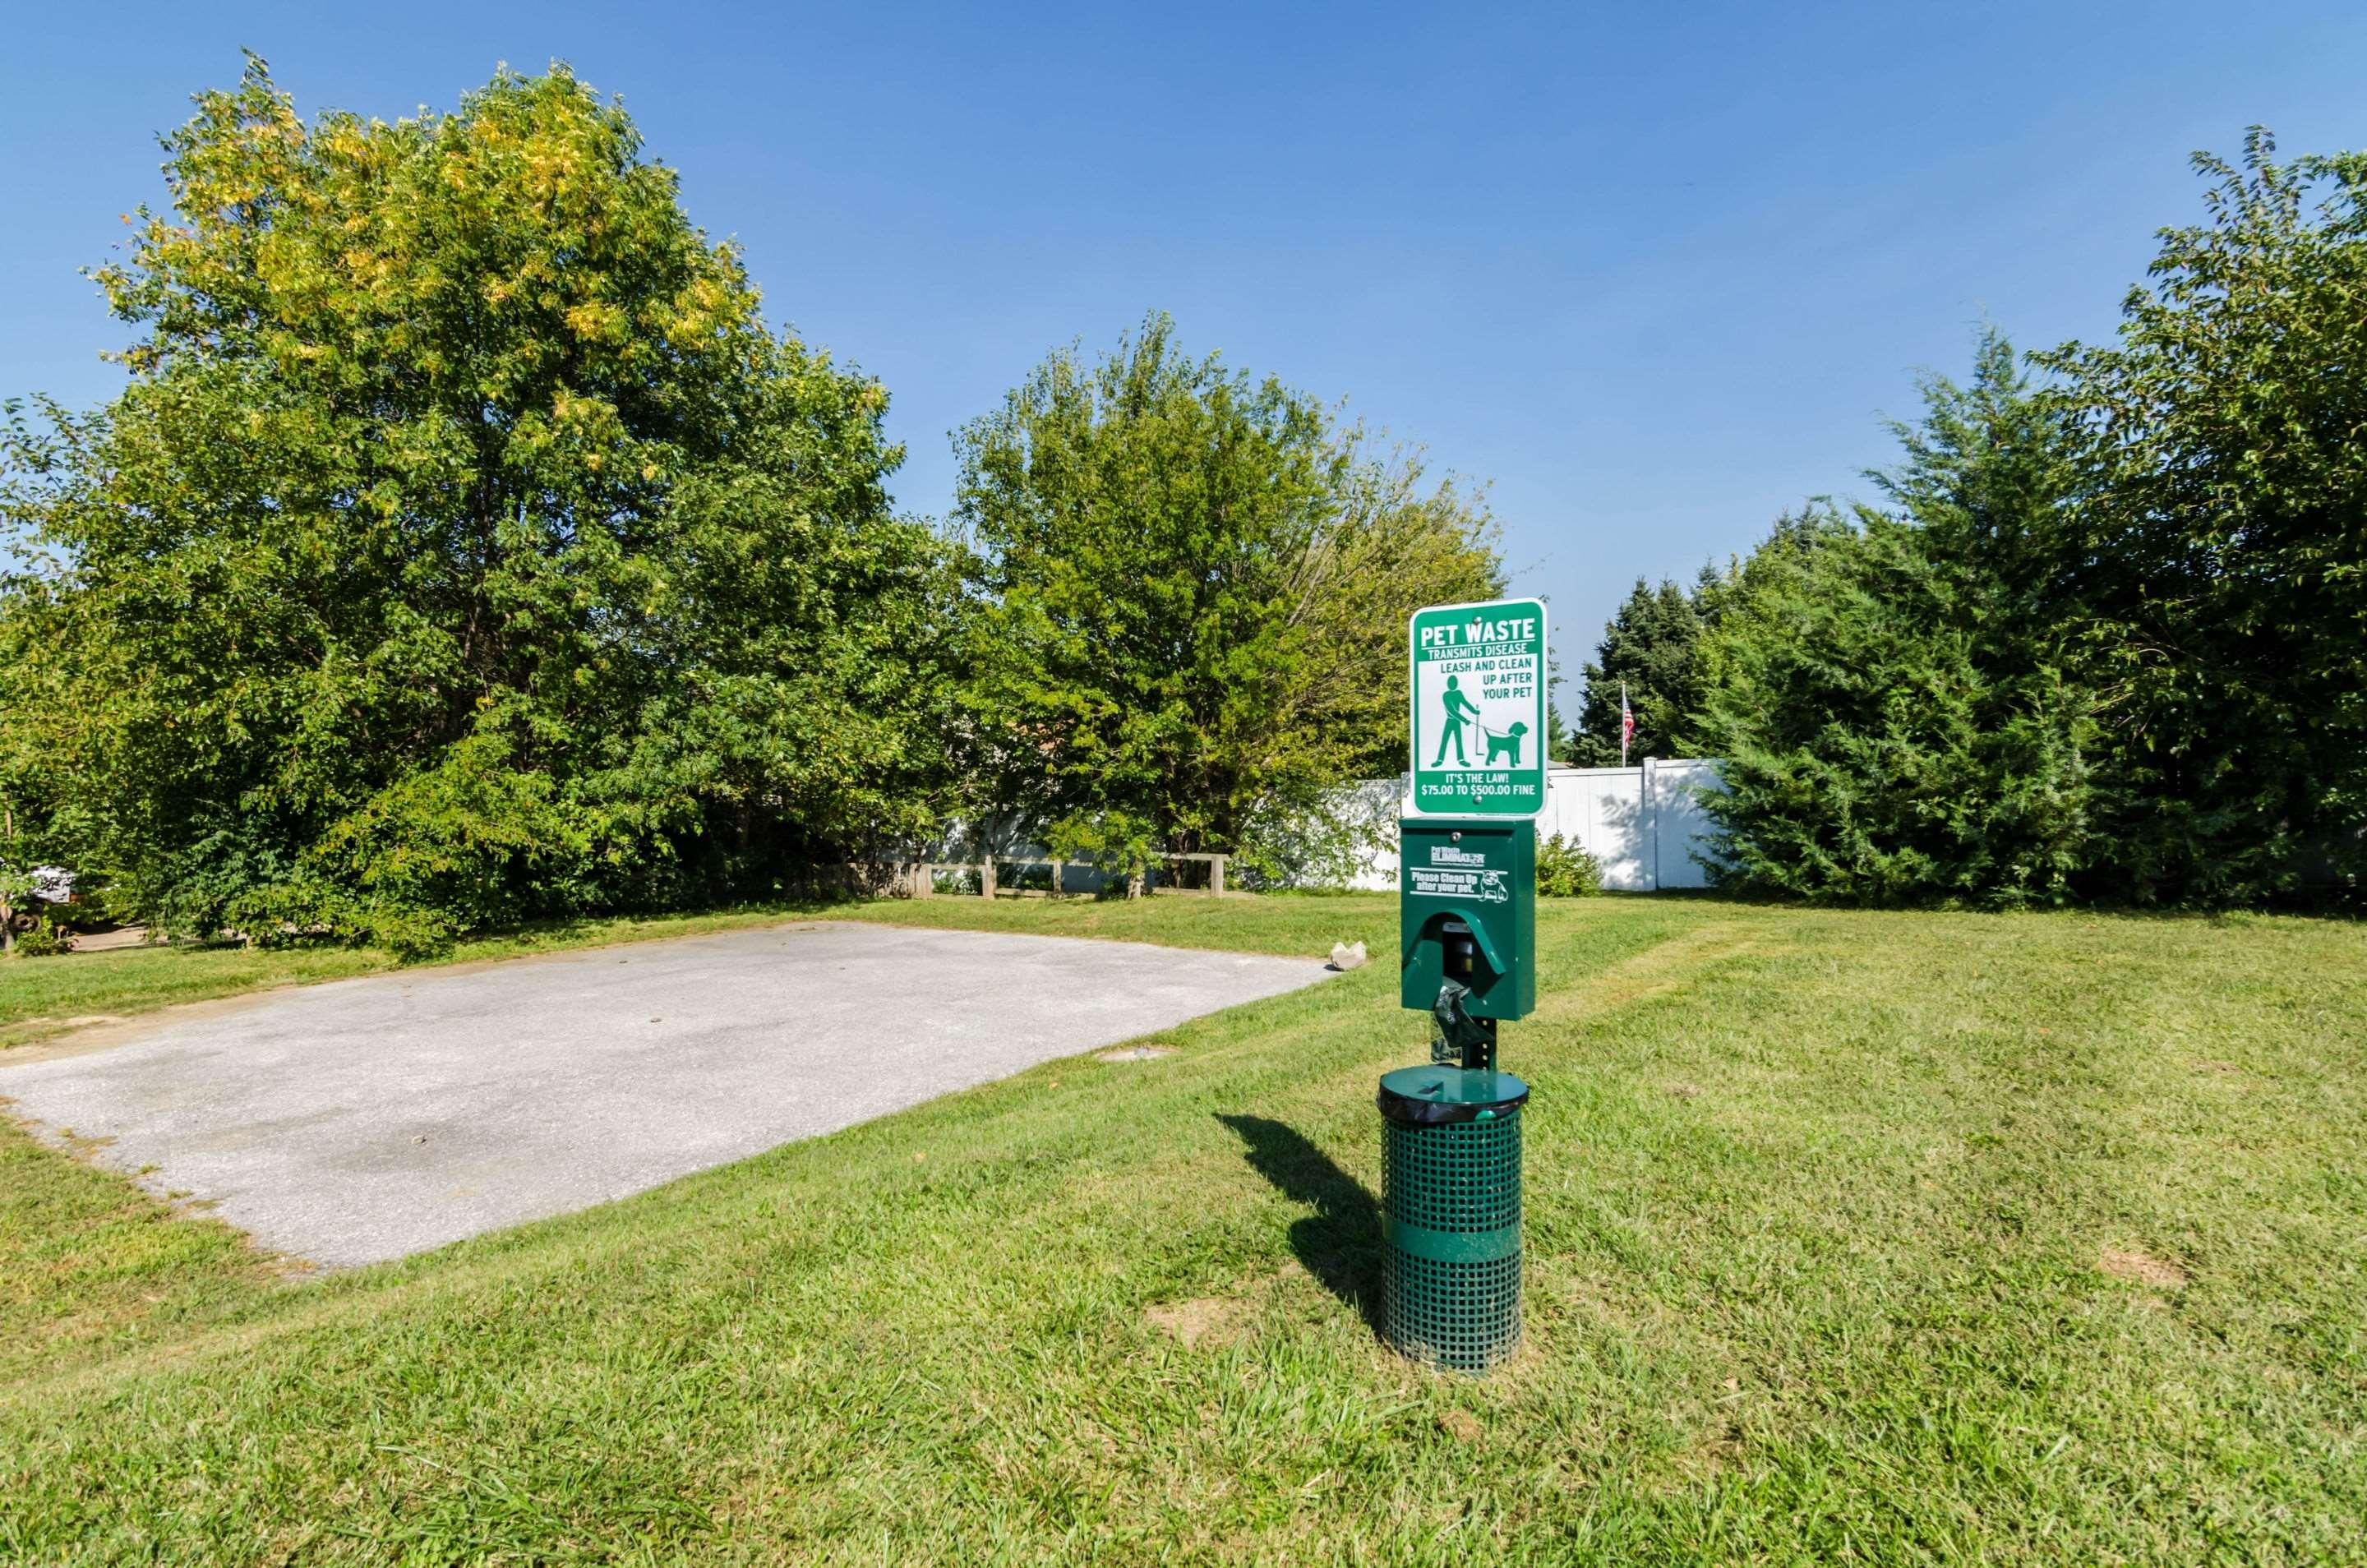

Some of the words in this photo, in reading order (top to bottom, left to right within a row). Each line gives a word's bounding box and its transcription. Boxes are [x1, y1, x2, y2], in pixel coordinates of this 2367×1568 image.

[1421, 625, 1458, 647] PET
[1465, 618, 1535, 643] WASTE
[1428, 647, 1482, 660] TRANSMITS
[1485, 643, 1527, 656] DISEASE
[1441, 662, 1471, 674] LEASH
[1474, 660, 1496, 671] AND
[1498, 657, 1532, 670] CLEAN
[1483, 675, 1497, 685] UP
[1499, 672, 1532, 685] AFTER
[1483, 689, 1509, 699] YOUR
[1513, 687, 1532, 698] PET
[1446, 773, 1463, 783] IT'S
[1466, 773, 1483, 783] THE
[1486, 773, 1509, 783] LAW!
[1421, 784, 1454, 796] $75.00
[1456, 785, 1468, 795] TO
[1470, 784, 1511, 796] $500.00
[1512, 785, 1535, 795] FINE
[1412, 871, 1439, 882] Please
[1441, 873, 1465, 883] Clean
[1465, 874, 1478, 885] Up
[1416, 881, 1437, 891] after
[1437, 883, 1457, 892] your
